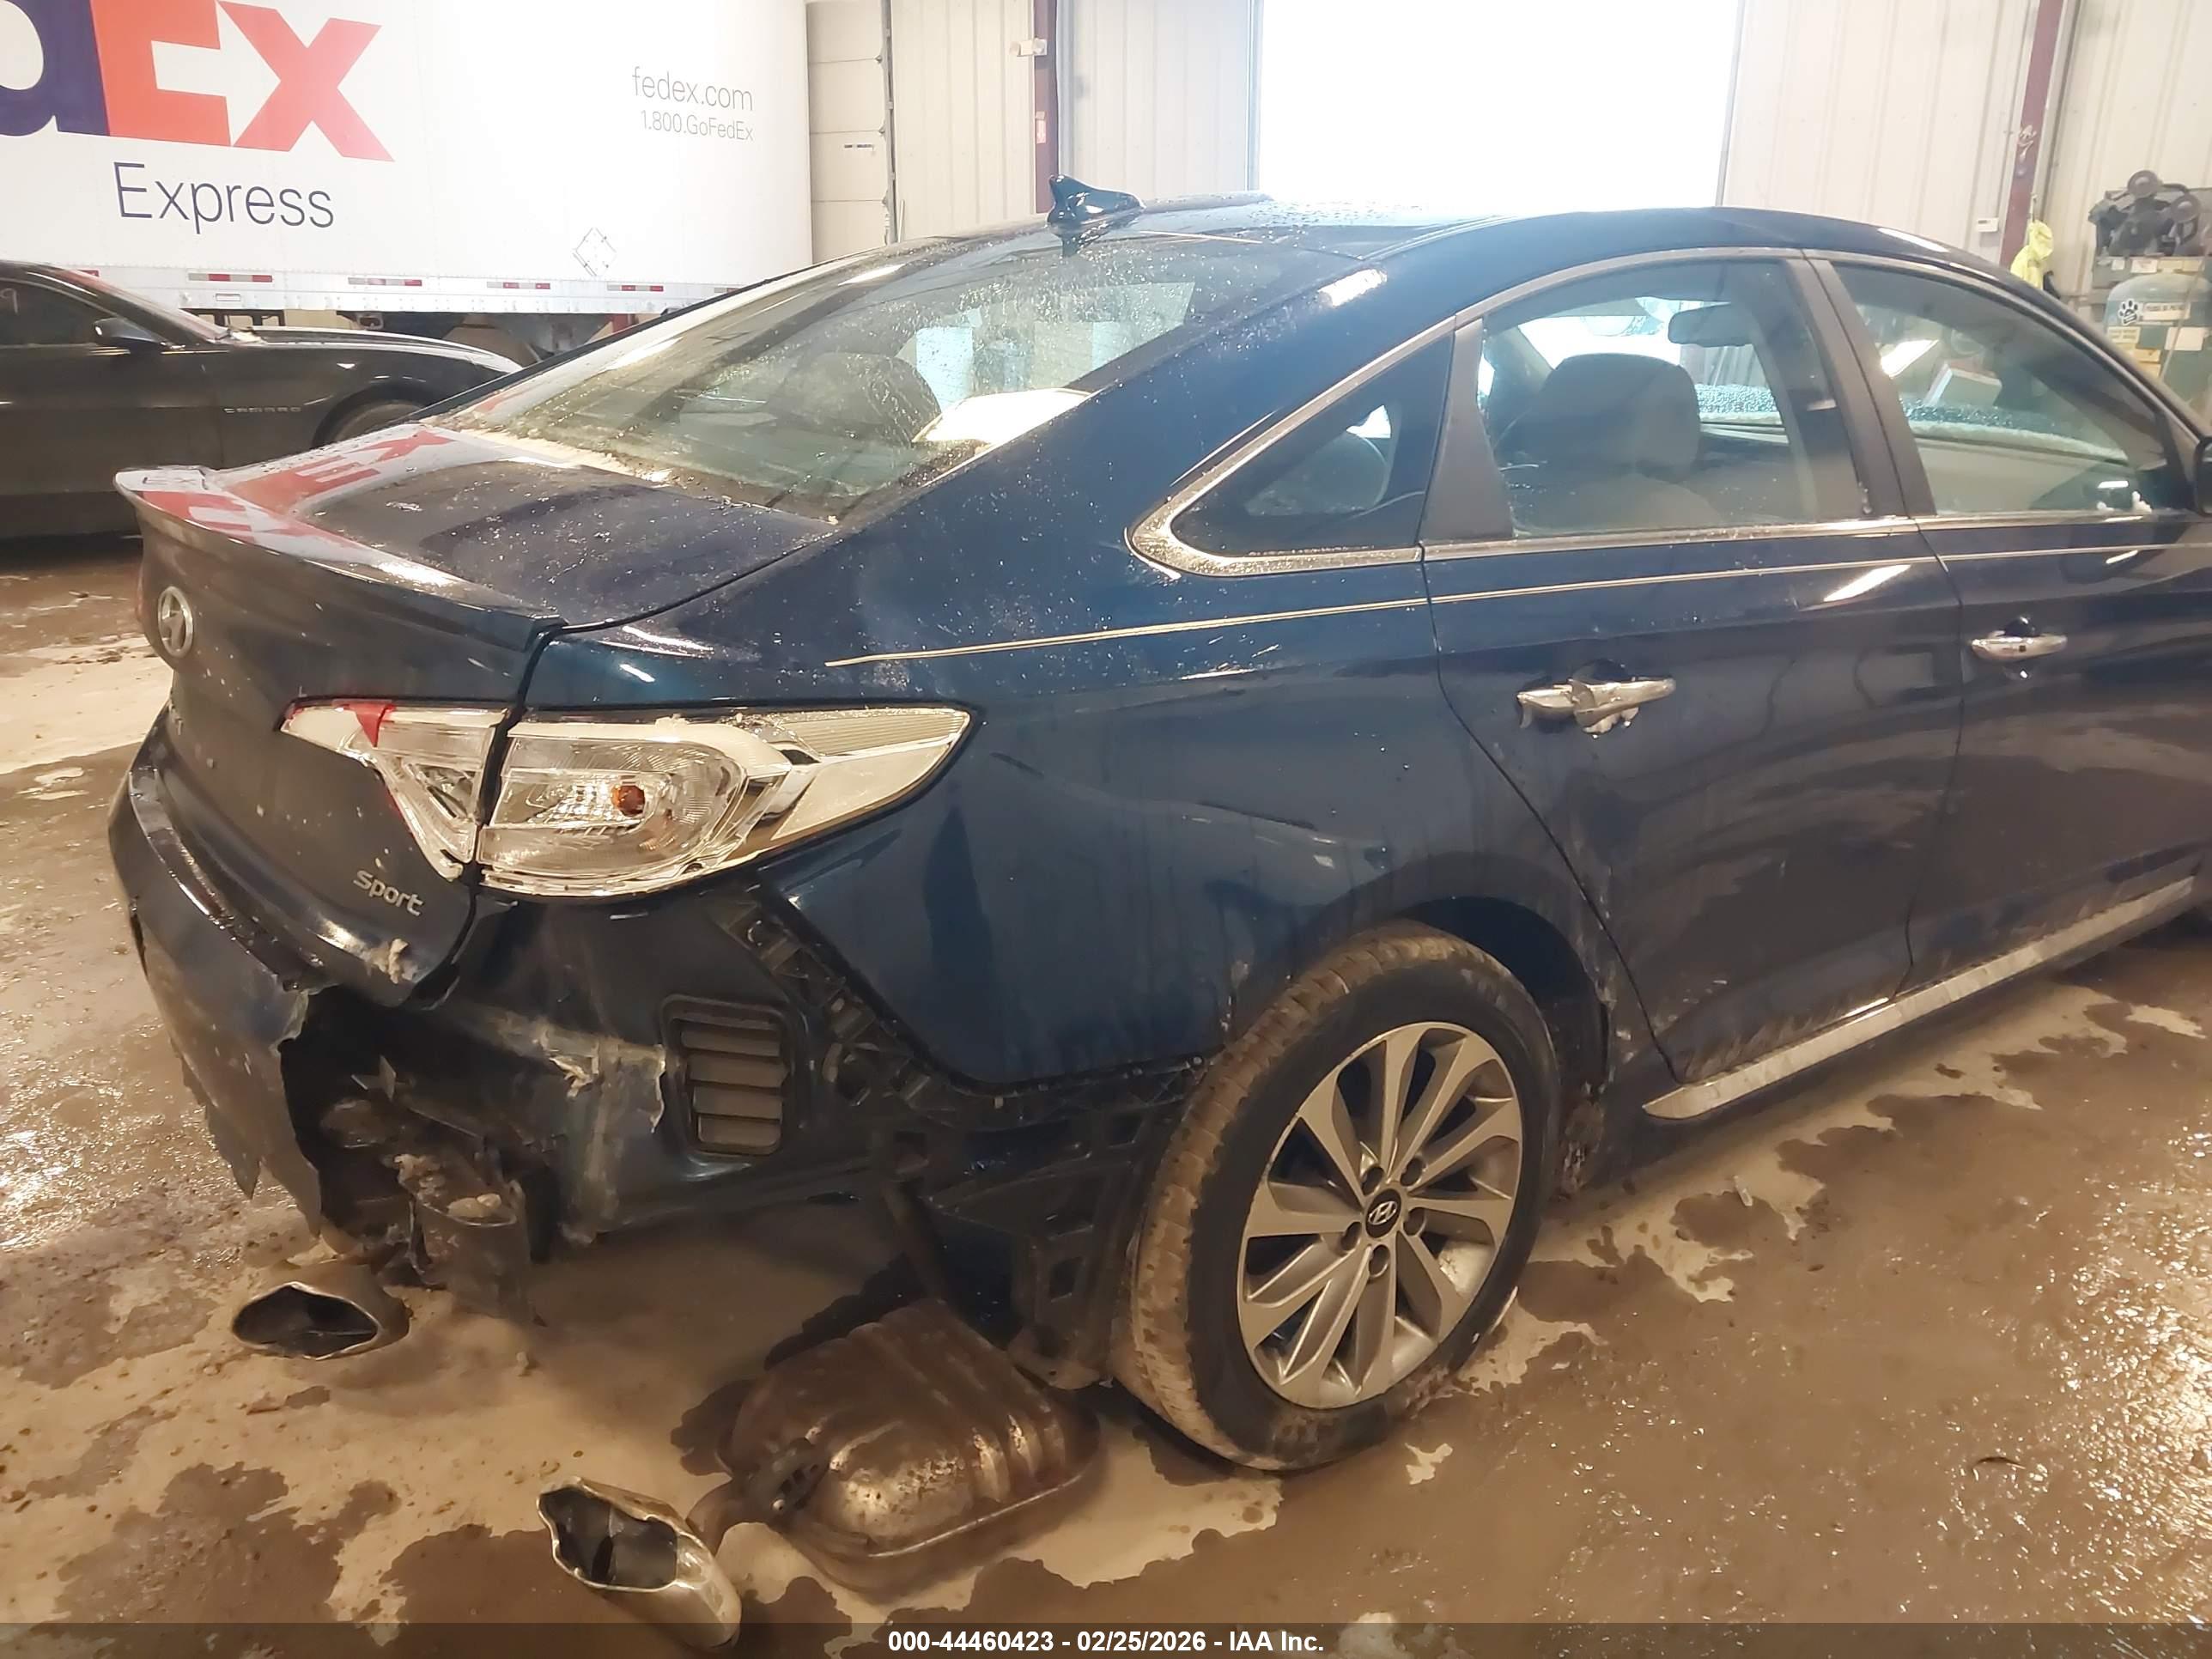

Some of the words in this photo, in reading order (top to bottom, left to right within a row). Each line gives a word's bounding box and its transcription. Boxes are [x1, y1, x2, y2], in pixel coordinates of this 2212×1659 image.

[632, 65, 753, 111] fedex.com
[641, 109, 753, 141] 1.800.GoFedEx
[114, 161, 334, 234] Express
